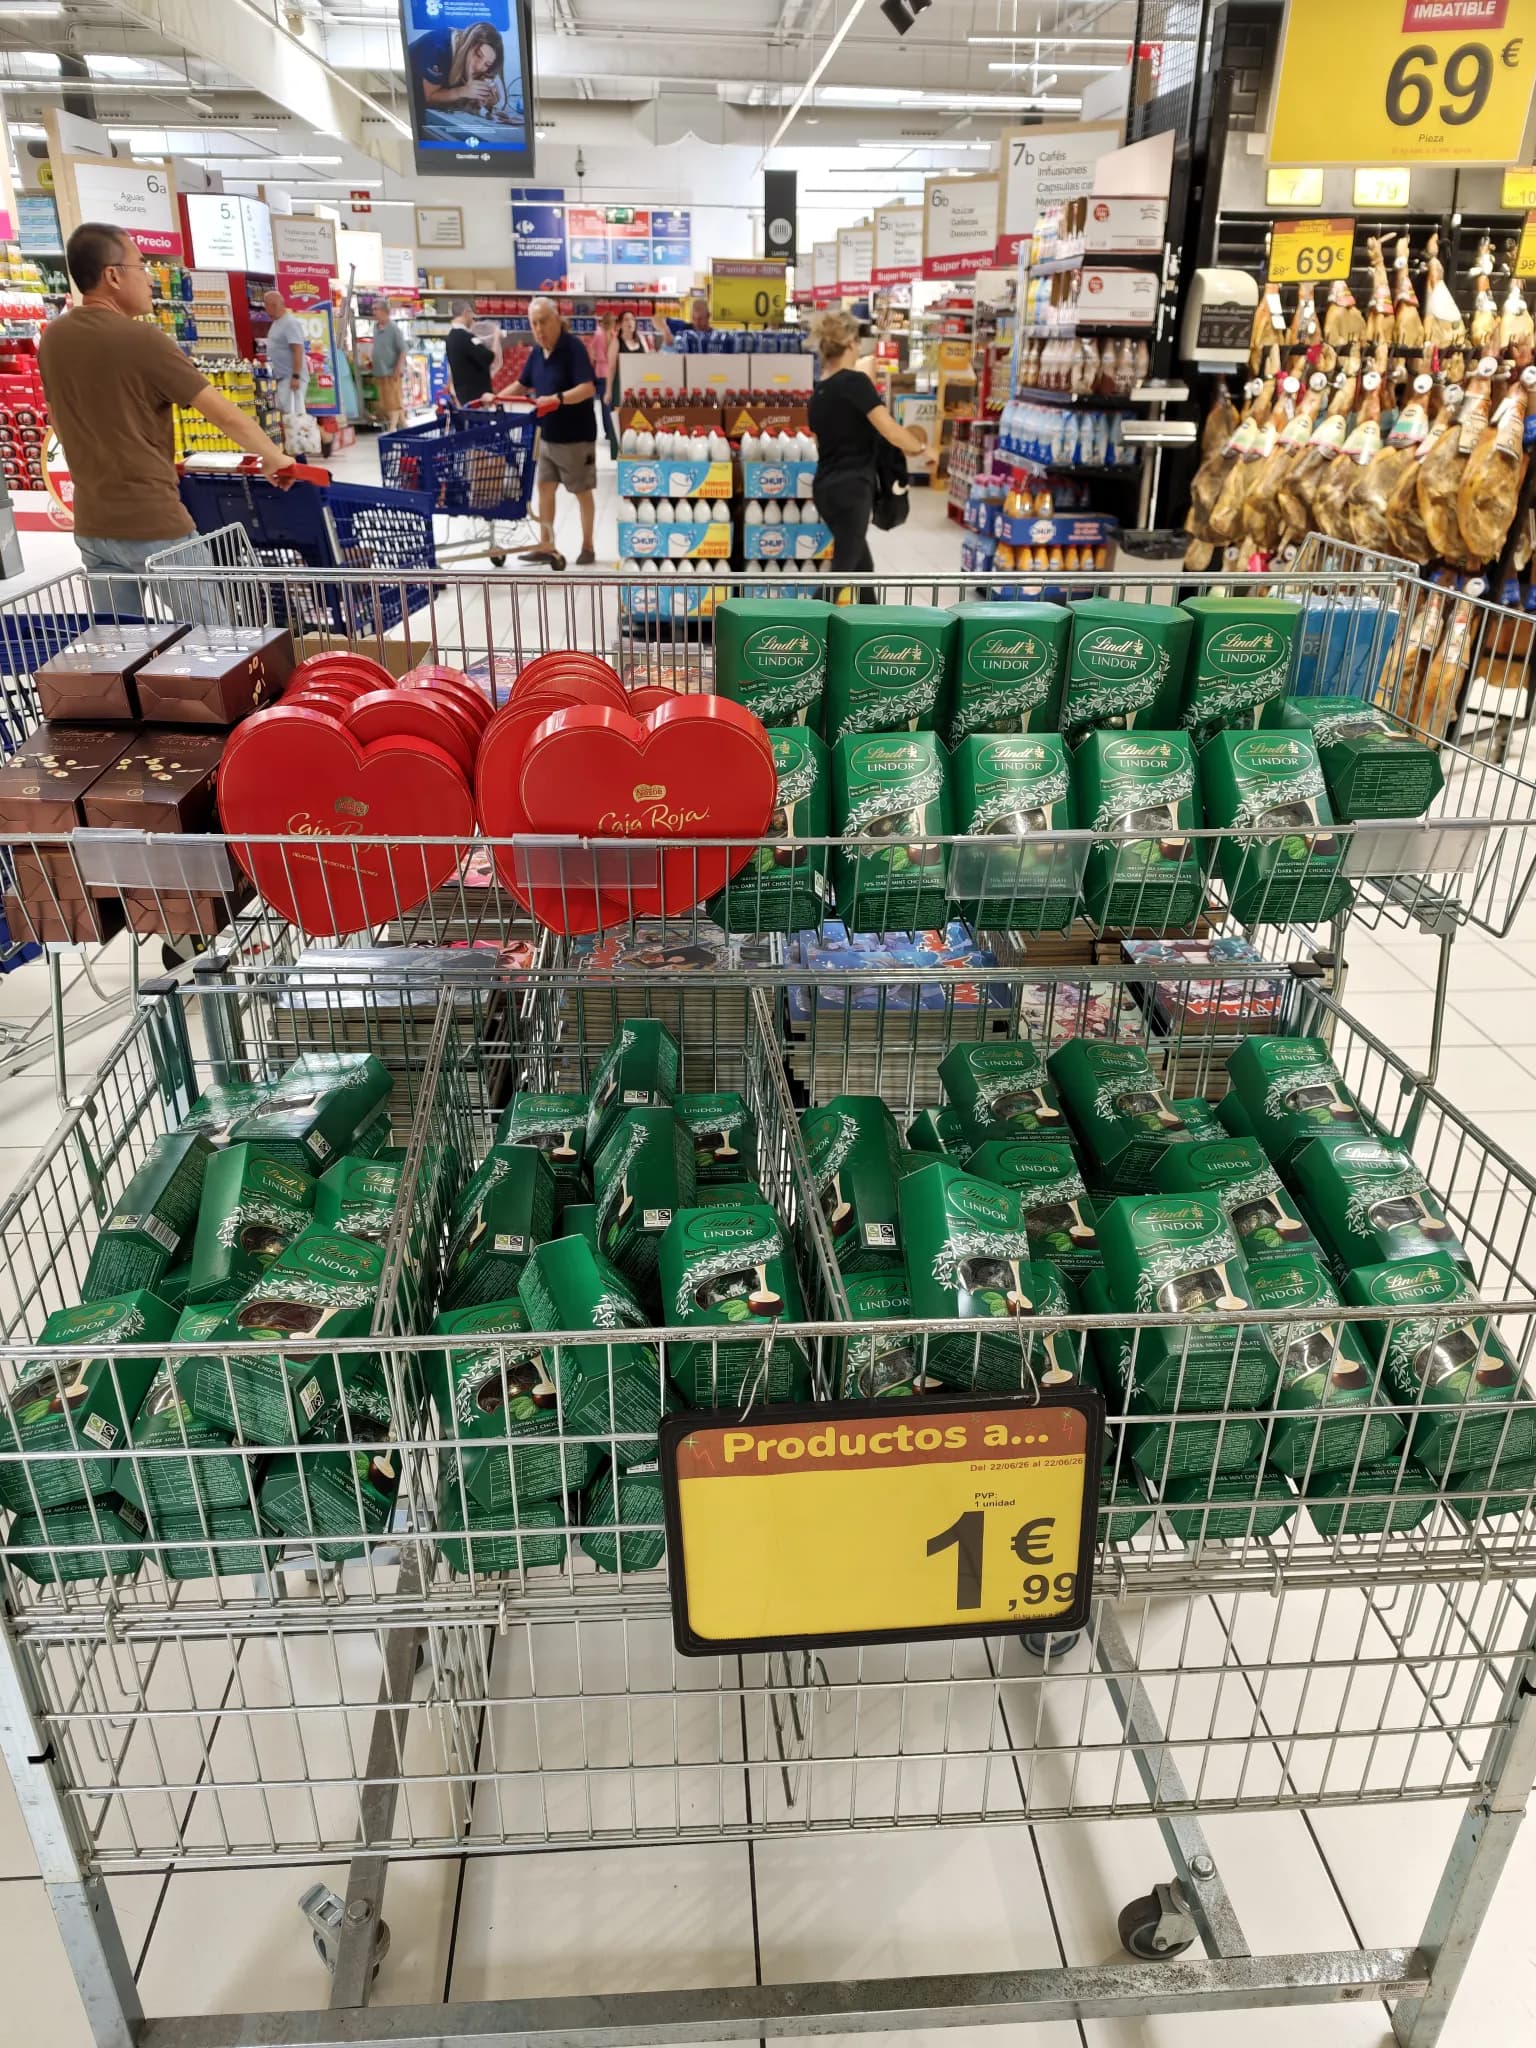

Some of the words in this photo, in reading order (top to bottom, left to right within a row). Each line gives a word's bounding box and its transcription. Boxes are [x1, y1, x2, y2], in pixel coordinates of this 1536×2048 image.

[1413, 1, 1497, 18] IMBATIBLE
[1385, 42, 1494, 126] 69
[1501, 38, 1524, 67] €
[1418, 134, 1444, 143] Pieza
[1012, 142, 1035, 166] 7b
[1039, 151, 1067, 162] Cafés
[1037, 165, 1088, 177] Infusiones
[146, 175, 167, 194] 6a
[931, 189, 949, 208] 6b
[113, 203, 146, 213] Sabores
[137, 235, 172, 248] Precio
[932, 260, 960, 273] Super
[961, 256, 993, 269] Precio
[1296, 246, 1334, 275] 69
[1336, 248, 1345, 262] €
[286, 265, 308, 275] Super
[755, 291, 769, 317] 0
[760, 635, 800, 652] Lindt
[986, 639, 1026, 655] Lindt
[1092, 636, 1136, 653] Lindt
[1221, 633, 1264, 649] Lindt
[872, 644, 911, 661] Lindt
[1220, 652, 1266, 664] LINDOR
[758, 655, 804, 667] LINDOR
[983, 659, 1029, 670] LINDOR
[1091, 655, 1137, 670] LINDOR
[870, 665, 916, 677] LINDOR
[867, 745, 909, 759] Lindt
[994, 746, 1037, 759] Lindt
[1117, 743, 1161, 757] Lindt
[1250, 743, 1289, 755] Lindt
[867, 760, 915, 772] LINDOR
[994, 760, 1042, 771] LINDOR
[1120, 758, 1168, 769] LINDOR
[1252, 756, 1299, 767] LINDOR
[598, 812, 643, 836] Caja
[641, 803, 709, 833] Roja
[984, 1059, 1024, 1067] LINDOR
[1102, 1058, 1139, 1069] LINDOR
[1275, 1053, 1319, 1063] LINDOR
[530, 1106, 570, 1115] LINDOR
[683, 1106, 723, 1115] LINDOR
[1344, 1147, 1386, 1161] Lindt
[1015, 1163, 1059, 1174] LINDOR
[1207, 1159, 1253, 1171] LINDOR
[1351, 1160, 1396, 1170] LINDOR
[262, 1176, 302, 1202] LINDOR
[362, 1183, 401, 1196] LINDO
[962, 1185, 1001, 1207] Lindt
[963, 1201, 1008, 1224] LINDOR
[1148, 1206, 1193, 1221] Lindt
[1151, 1220, 1204, 1233] LINDOR
[703, 1229, 754, 1239] LINDOR
[307, 1253, 358, 1278] LINDOR
[1385, 1270, 1428, 1289] Lindt
[1260, 1286, 1305, 1302] INDOR
[1392, 1284, 1445, 1302] LINDOR
[859, 1297, 910, 1312] LINDOR
[55, 1319, 105, 1339] LINDOR
[723, 1424, 967, 1463] Productos
[970, 1464, 986, 1472] Del
[990, 1462, 1030, 1471] 22/06/26
[1032, 1460, 1041, 1468] al
[1044, 1457, 1083, 1467] 22/06/26
[983, 1499, 1016, 1507] unidad
[1010, 1517, 1056, 1565] €
[926, 1511, 985, 1610] 1
